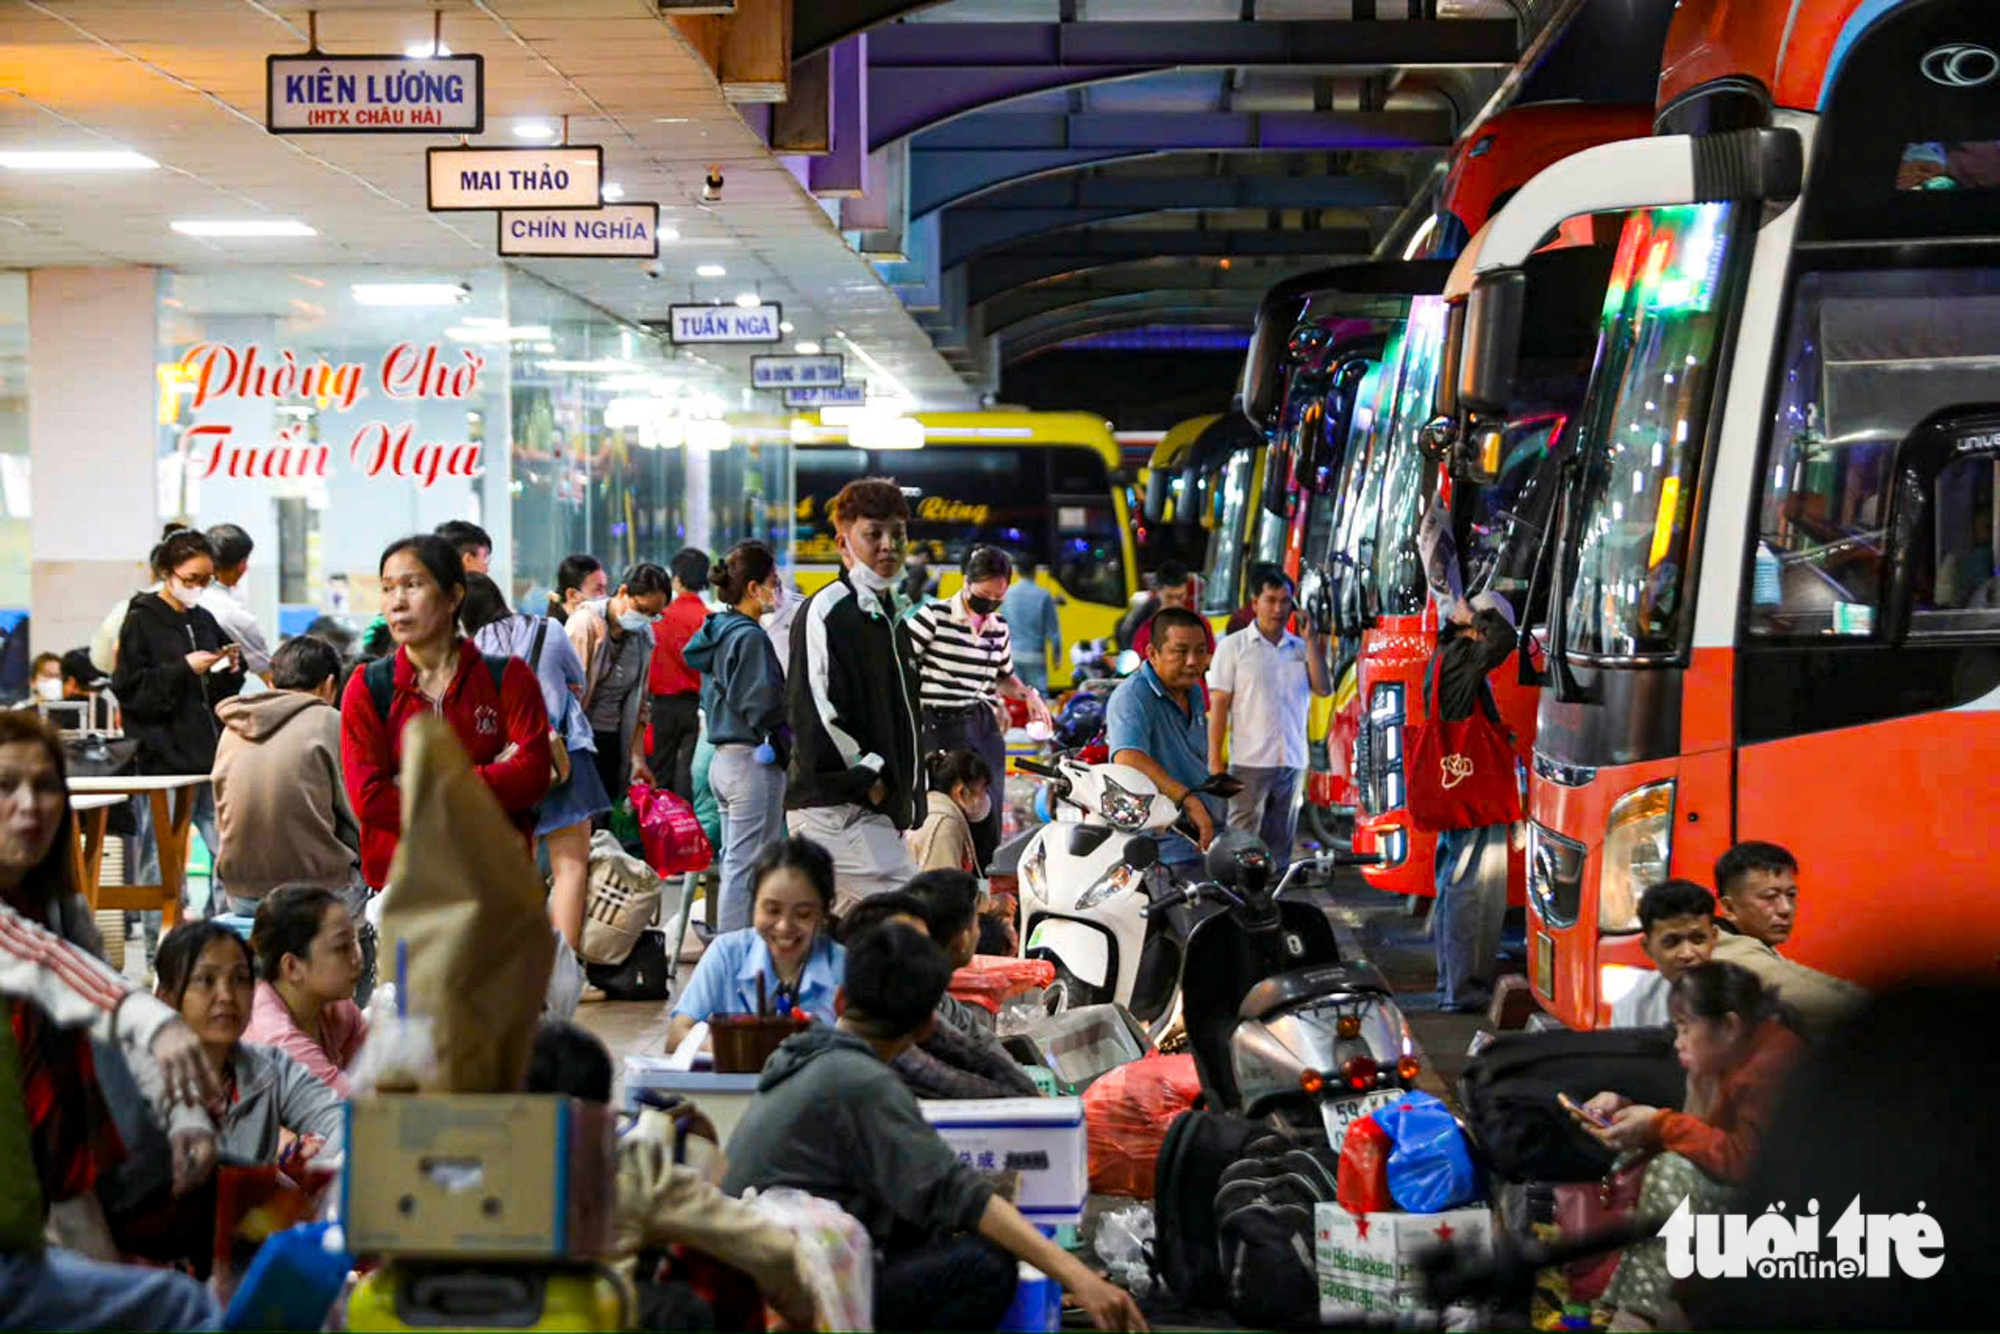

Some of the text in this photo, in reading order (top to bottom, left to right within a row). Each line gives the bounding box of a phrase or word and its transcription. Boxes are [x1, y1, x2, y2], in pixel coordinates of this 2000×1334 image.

[286, 66, 463, 104] KIÊN LƯƠNG
[308, 106, 442, 125] (HTX CHÂU HÀ)
[460, 162, 569, 190] MAI THẢO
[511, 216, 647, 239] CHÍN NGHĨA
[680, 308, 771, 336] TUẤN NGA
[180, 342, 484, 410] Phòng Chờ
[184, 423, 485, 488] Tuấn Nga
